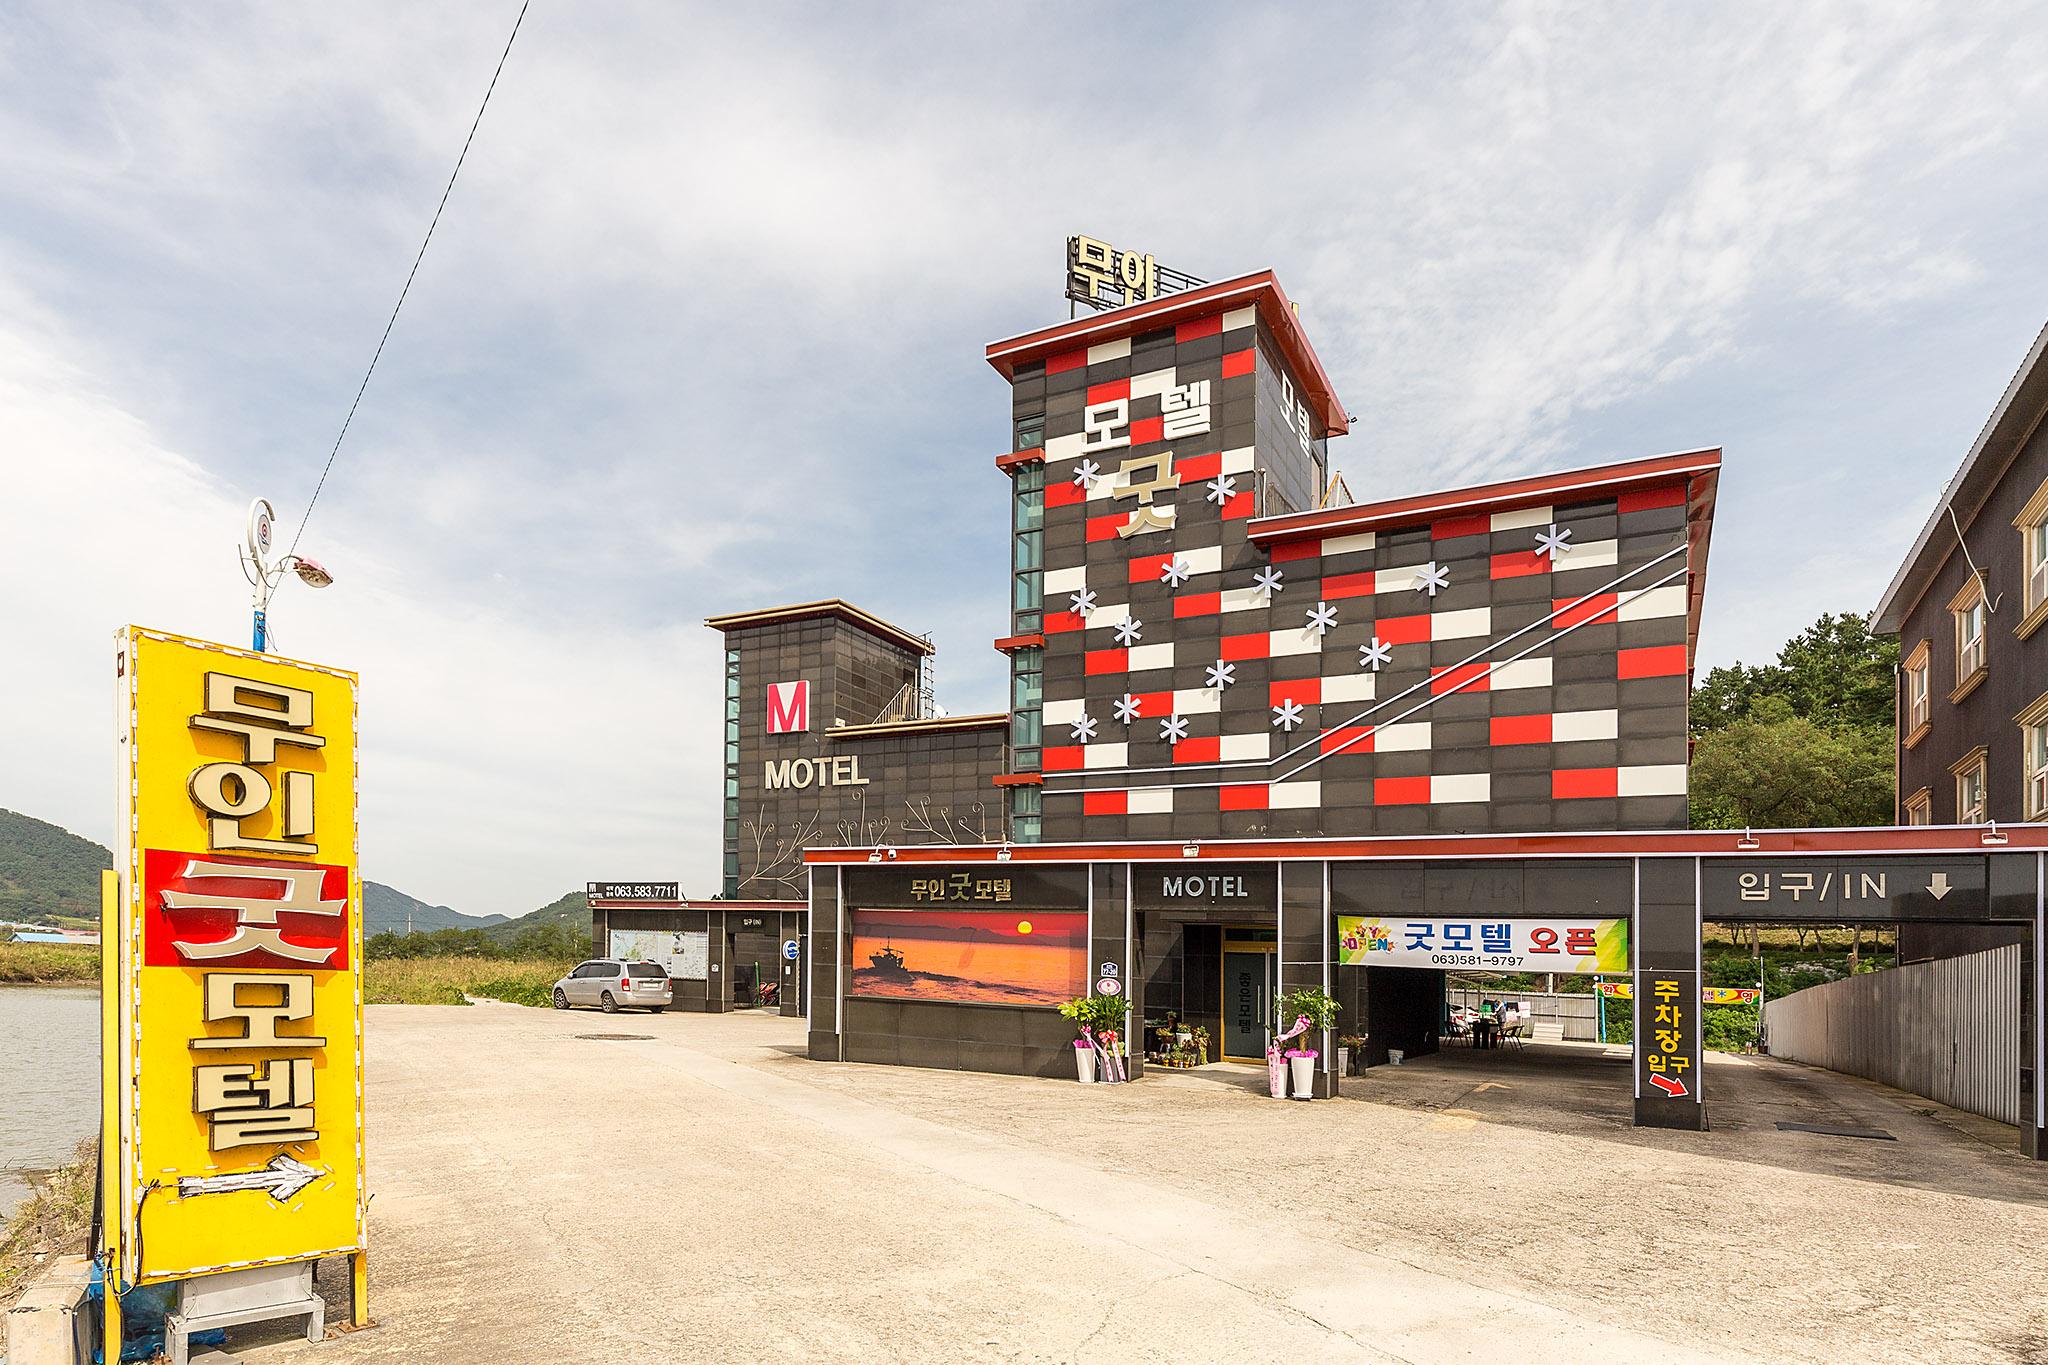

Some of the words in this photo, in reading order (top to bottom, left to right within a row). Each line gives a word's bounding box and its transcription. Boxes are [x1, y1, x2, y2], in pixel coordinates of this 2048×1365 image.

[1081, 379, 1211, 453] 모텔
[1280, 369, 1310, 458] 모텔
[1113, 450, 1182, 539] 굿
[766, 680, 807, 734] M
[765, 755, 870, 789] MOTEL
[614, 885, 677, 897] 063.583.7711
[1163, 876, 1248, 897] MOTEL
[1738, 872, 1887, 901] 입구/IN
[1346, 937, 1389, 952] OPEN
[1404, 923, 1512, 954] 굿모텔
[1528, 927, 1598, 956] 오픈
[1654, 980, 1683, 1054] 주차장
[1647, 1054, 1690, 1074] 입구
